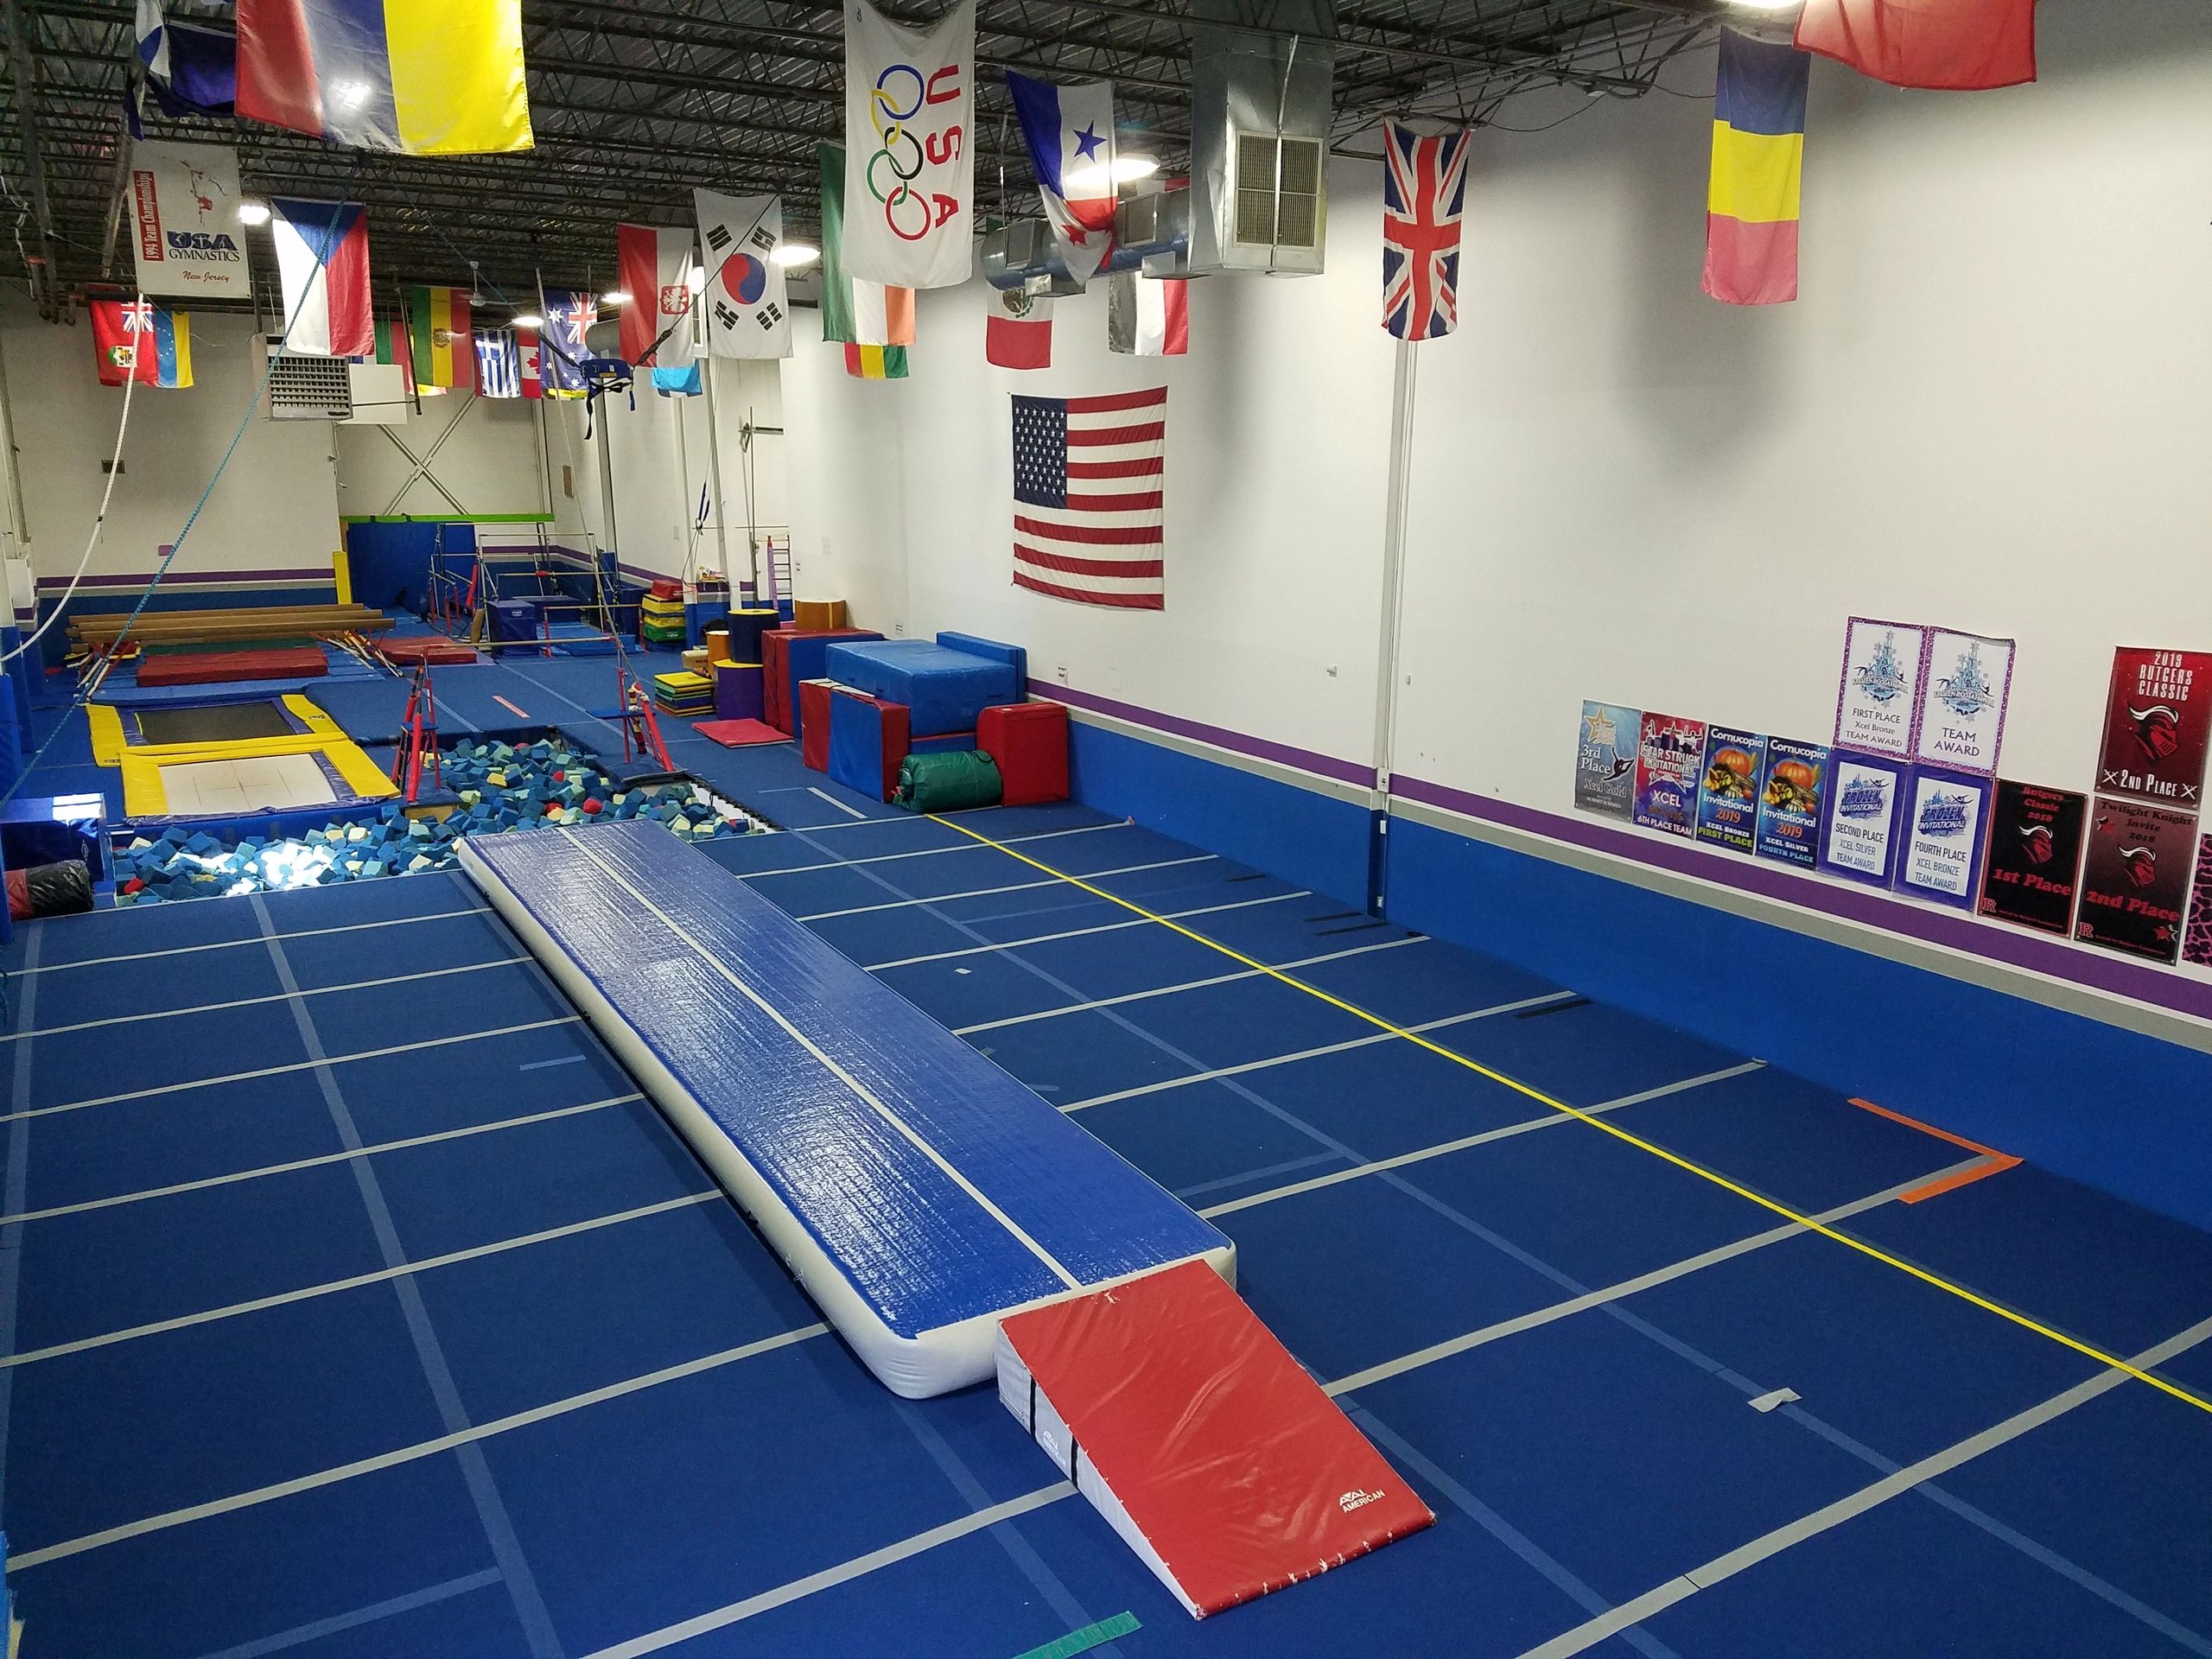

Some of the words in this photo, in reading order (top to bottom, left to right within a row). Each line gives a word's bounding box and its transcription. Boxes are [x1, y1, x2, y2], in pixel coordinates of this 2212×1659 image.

[925, 64, 963, 229] USA
[137, 172, 156, 223] Championships
[144, 223, 159, 242] Team
[167, 231, 238, 251] USA
[169, 248, 240, 262] GYMNASTICS
[182, 270, 201, 280] New
[201, 271, 230, 283] Jersey
[2154, 651, 2183, 667] 2019
[2139, 664, 2193, 686] RUTGERS
[2138, 680, 2188, 702] CLASSIC
[1853, 708, 1874, 719] FIRST
[1875, 712, 1901, 724] PLACE
[1855, 721, 1870, 731] Xcel
[1872, 725, 1896, 735] Bronze
[1942, 728, 1976, 743] TEAM
[1710, 728, 1764, 748] Cornucopia
[1846, 731, 1869, 742] TEAM
[1870, 735, 1903, 747] AWARD
[1581, 745, 1601, 759] 3rd
[1643, 745, 1664, 759] STAR
[1665, 749, 1700, 766] STRUCK
[1770, 739, 1827, 760] Cornucopia
[1934, 741, 1980, 756] AWARD
[1581, 758, 1611, 775] Place
[1645, 757, 1694, 775] INVITATIONAL
[1584, 779, 1603, 792] Xcel
[1605, 783, 1626, 798] Gold
[1842, 790, 1881, 804] FROZEN
[2021, 786, 2064, 802] Rutgers
[1653, 790, 1681, 807] XCEL
[1703, 792, 1754, 813] Invitational
[2024, 798, 2059, 812] Classic
[1715, 808, 1741, 823] 2019
[1840, 804, 1881, 812] INVITATIONAL
[1922, 806, 1965, 821] FROZEN
[2101, 801, 2148, 818] Twilight
[2152, 811, 2193, 826] Knight
[1637, 815, 1649, 824] 6TH
[1650, 818, 1672, 830] PLACE
[1673, 823, 1692, 836] TEAM
[1763, 807, 1816, 828] Invitational
[1918, 820, 1965, 829] INVITATIONAL
[2126, 819, 2161, 832] Invite
[1698, 826, 1723, 839] FIRST
[1724, 833, 1753, 848] PLACE
[1706, 821, 1723, 831] XCEL
[1724, 826, 1750, 837] BRONZE
[1776, 823, 1802, 838] 2019
[1836, 823, 1861, 838] SECOND
[1862, 830, 1884, 843] PLACE
[1765, 836, 1784, 846] XCEL
[1785, 841, 1808, 852] SILVER
[1839, 839, 1854, 851] XCEL
[1855, 843, 1876, 856] SILVER
[1915, 841, 1942, 857] FOURTH
[1943, 847, 1967, 863] PLACE
[1759, 843, 1788, 856] FOURTH
[1789, 850, 1814, 863] PLACE
[1836, 852, 1853, 865] TEAM
[1853, 857, 1875, 871] AWARD
[1916, 857, 1932, 870] XCEL
[1933, 861, 1960, 877] BRONZE
[1915, 871, 1932, 885] TEAM
[1933, 876, 1957, 891] AWARD
[1992, 868, 2020, 884] 1st
[2024, 874, 2072, 896] Place
[1983, 897, 1996, 913] R
[2085, 891, 2123, 908] 2nd
[2127, 897, 2180, 922] Place
[2079, 922, 2094, 938] R
[1342, 1489, 1386, 1513] AMERICAN
